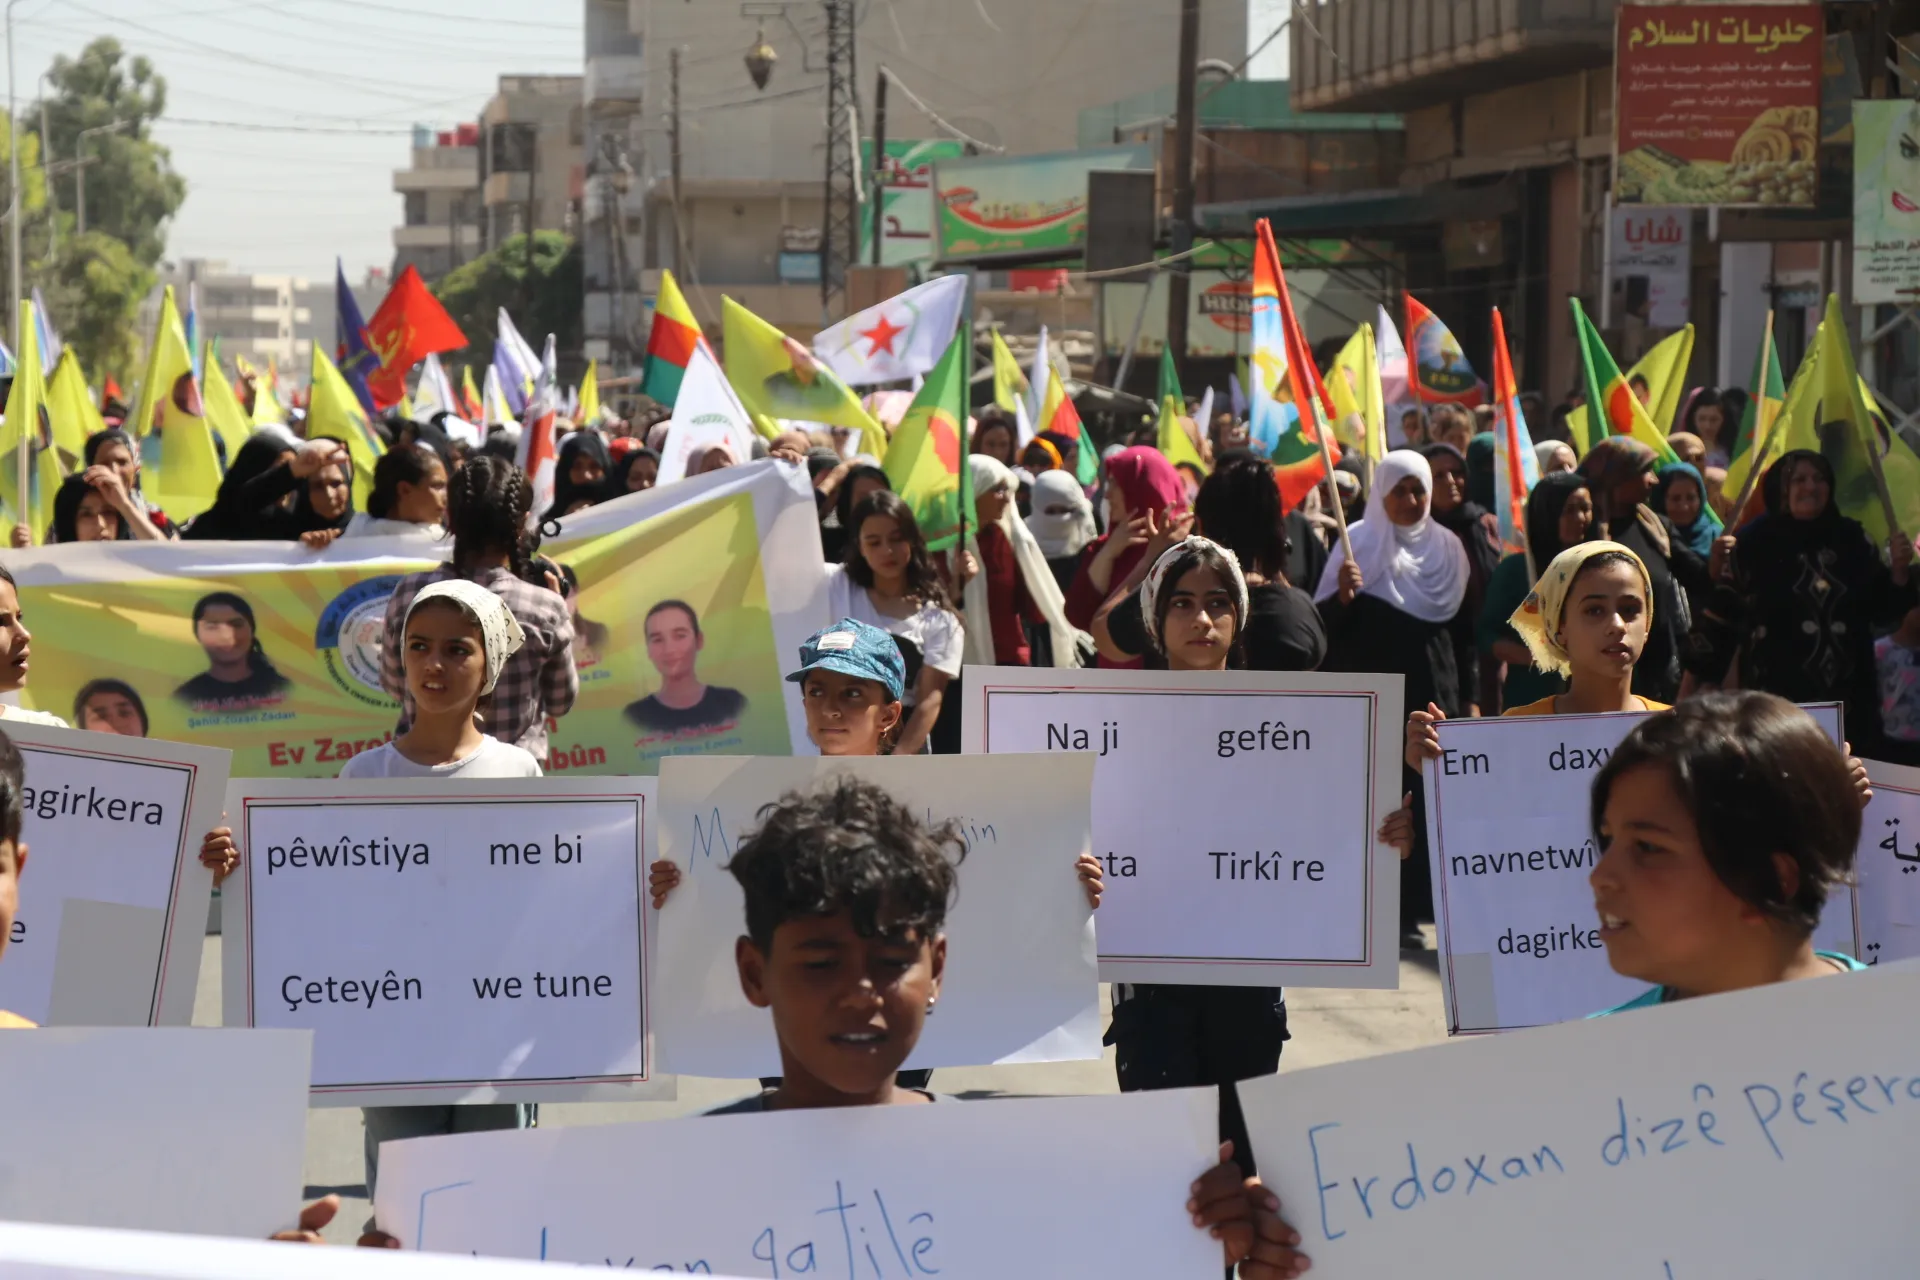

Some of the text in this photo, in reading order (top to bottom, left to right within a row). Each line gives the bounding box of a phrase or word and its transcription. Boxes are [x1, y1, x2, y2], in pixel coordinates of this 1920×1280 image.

[1628, 17, 1814, 53] حلويات السلام
[267, 741, 305, 768] Ev
[544, 743, 606, 772] bûn
[1046, 721, 1311, 758] Na ji gefên
[1443, 748, 1490, 776] Em
[266, 834, 583, 876] pêwîstiya me bi
[1208, 850, 1283, 881] Tirkî
[1292, 856, 1325, 883] re
[1452, 838, 1595, 876] navnetwî
[1497, 923, 1603, 959] dagirke
[281, 970, 613, 1012] Çeteyên we tune
[1308, 1121, 1565, 1241] Erdoxan
[1600, 1082, 1727, 1169] dizê
[752, 1179, 941, 1280] qatilê
